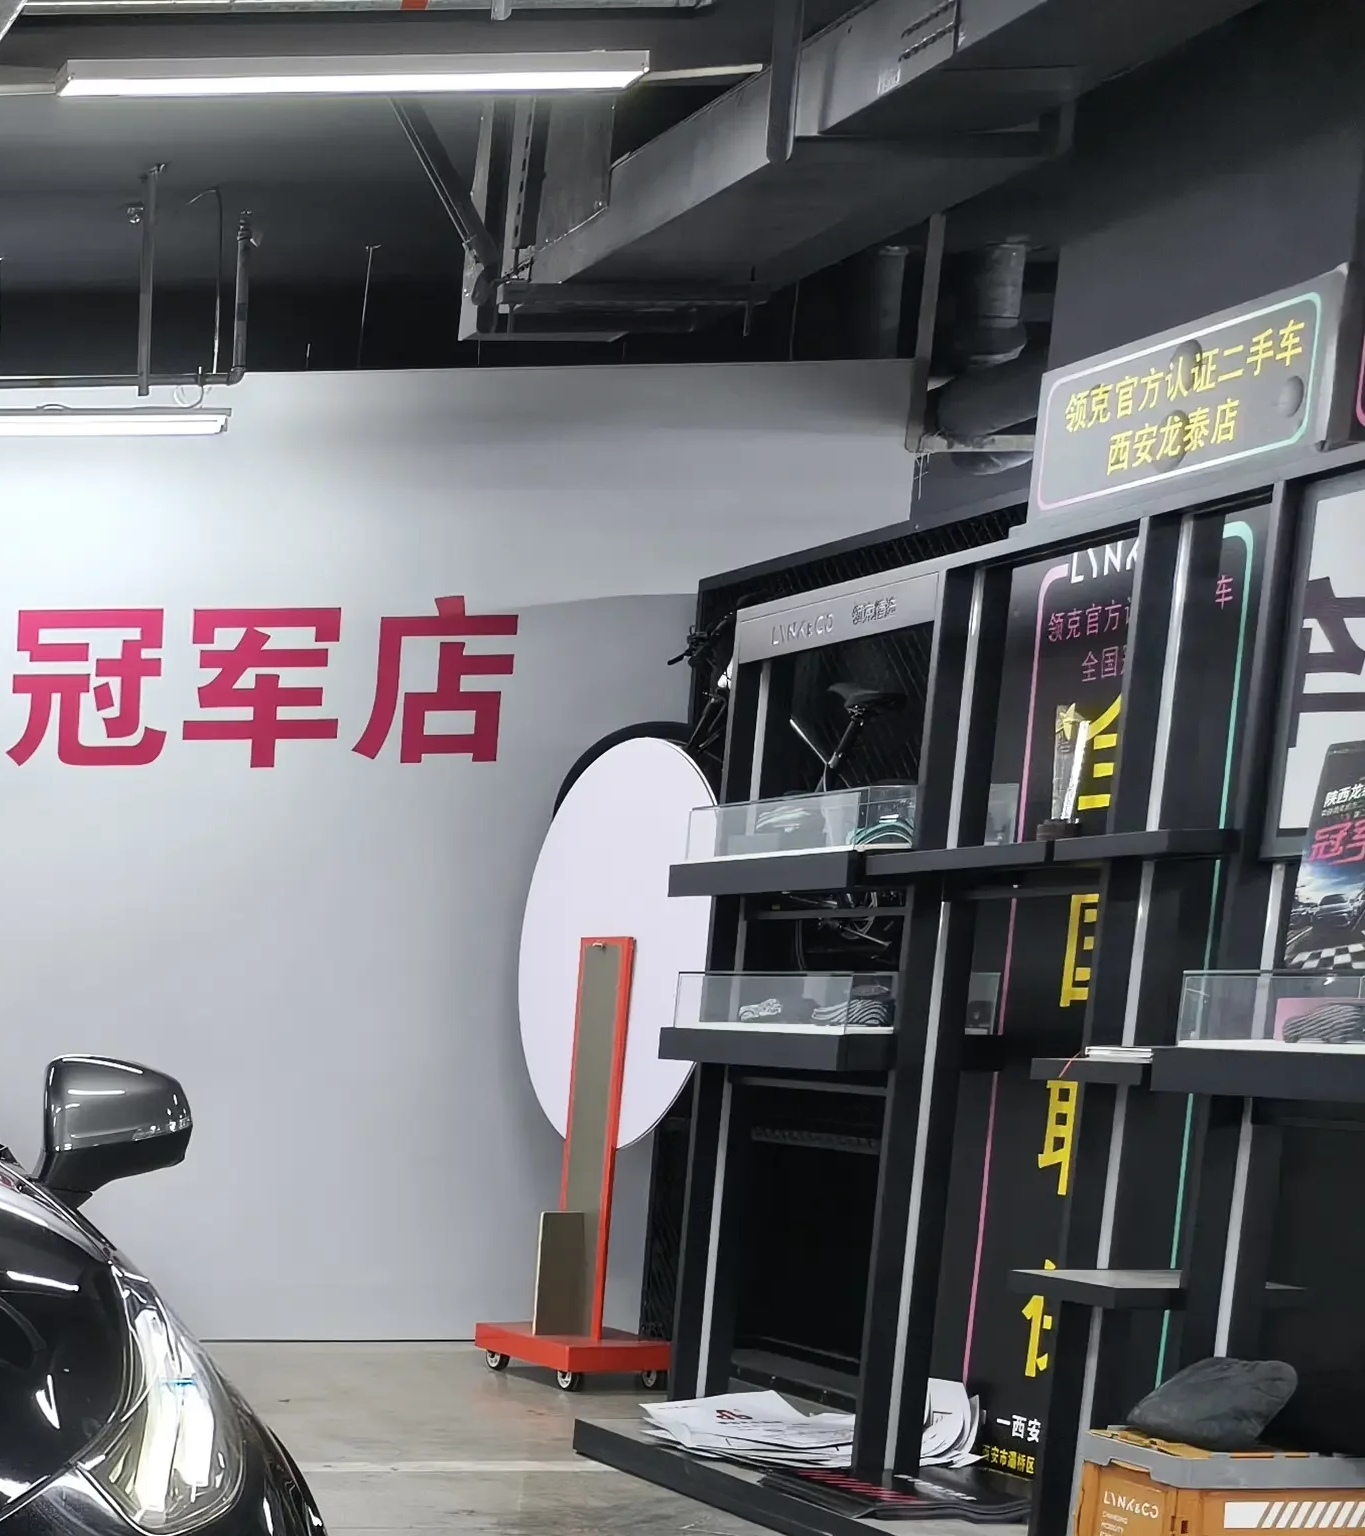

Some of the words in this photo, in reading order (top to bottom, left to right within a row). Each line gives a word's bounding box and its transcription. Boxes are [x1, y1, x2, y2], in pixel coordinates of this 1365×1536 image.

[1065, 319, 1305, 433] 领克官方认证二手车
[1106, 397, 1240, 476] 西安龙泰店
